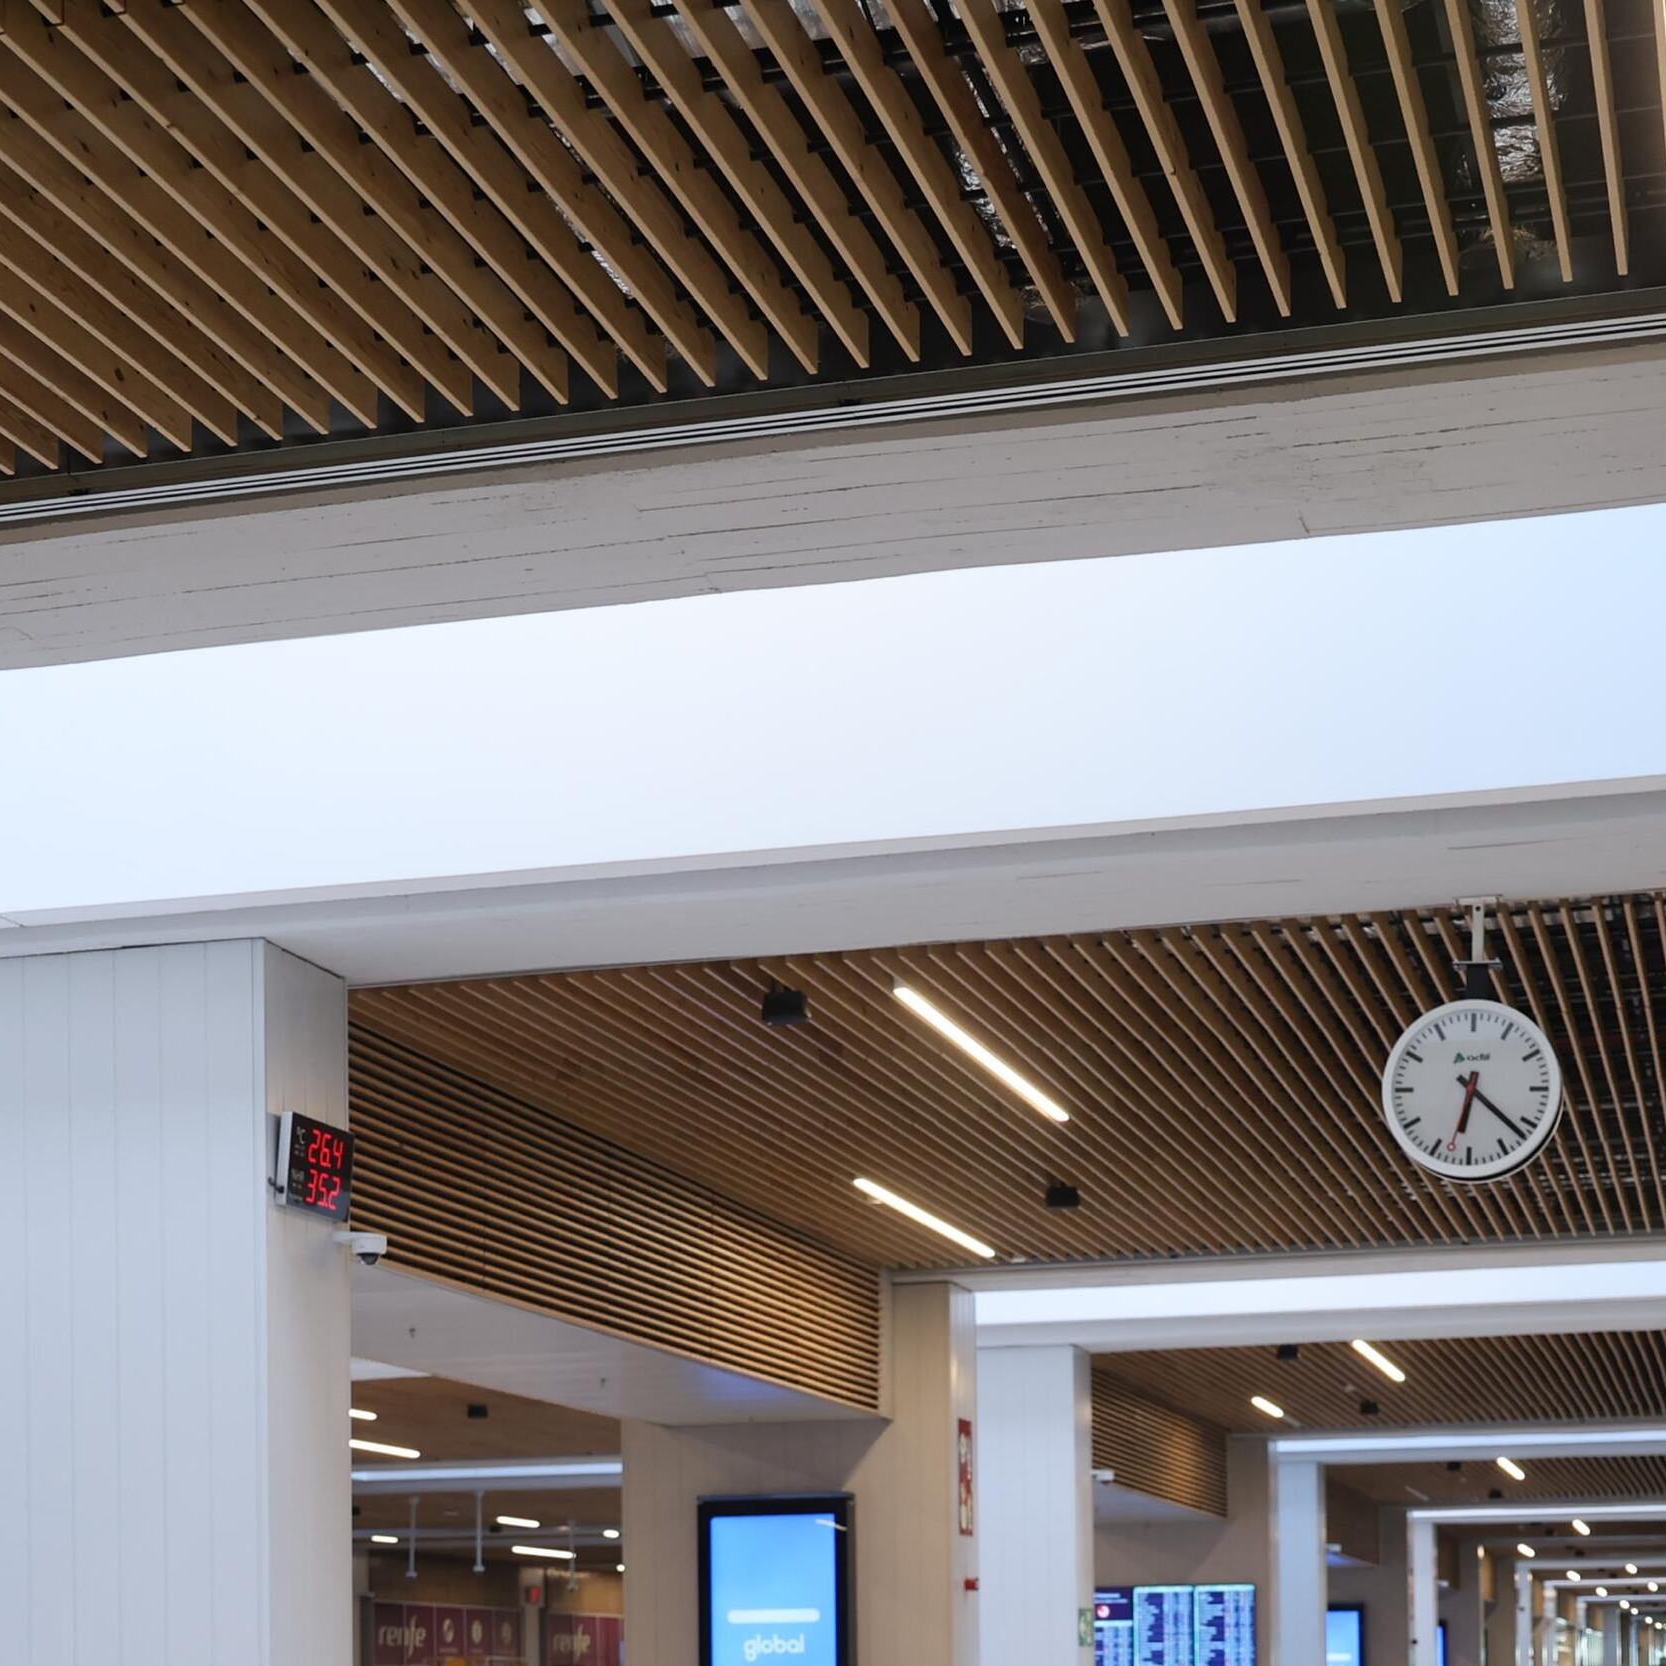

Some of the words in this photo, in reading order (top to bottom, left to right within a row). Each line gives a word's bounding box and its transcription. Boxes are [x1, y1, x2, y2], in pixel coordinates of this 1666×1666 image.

[377, 1615, 427, 1656] renfe
[552, 1624, 591, 1658] renfe
[743, 1633, 805, 1662] global
